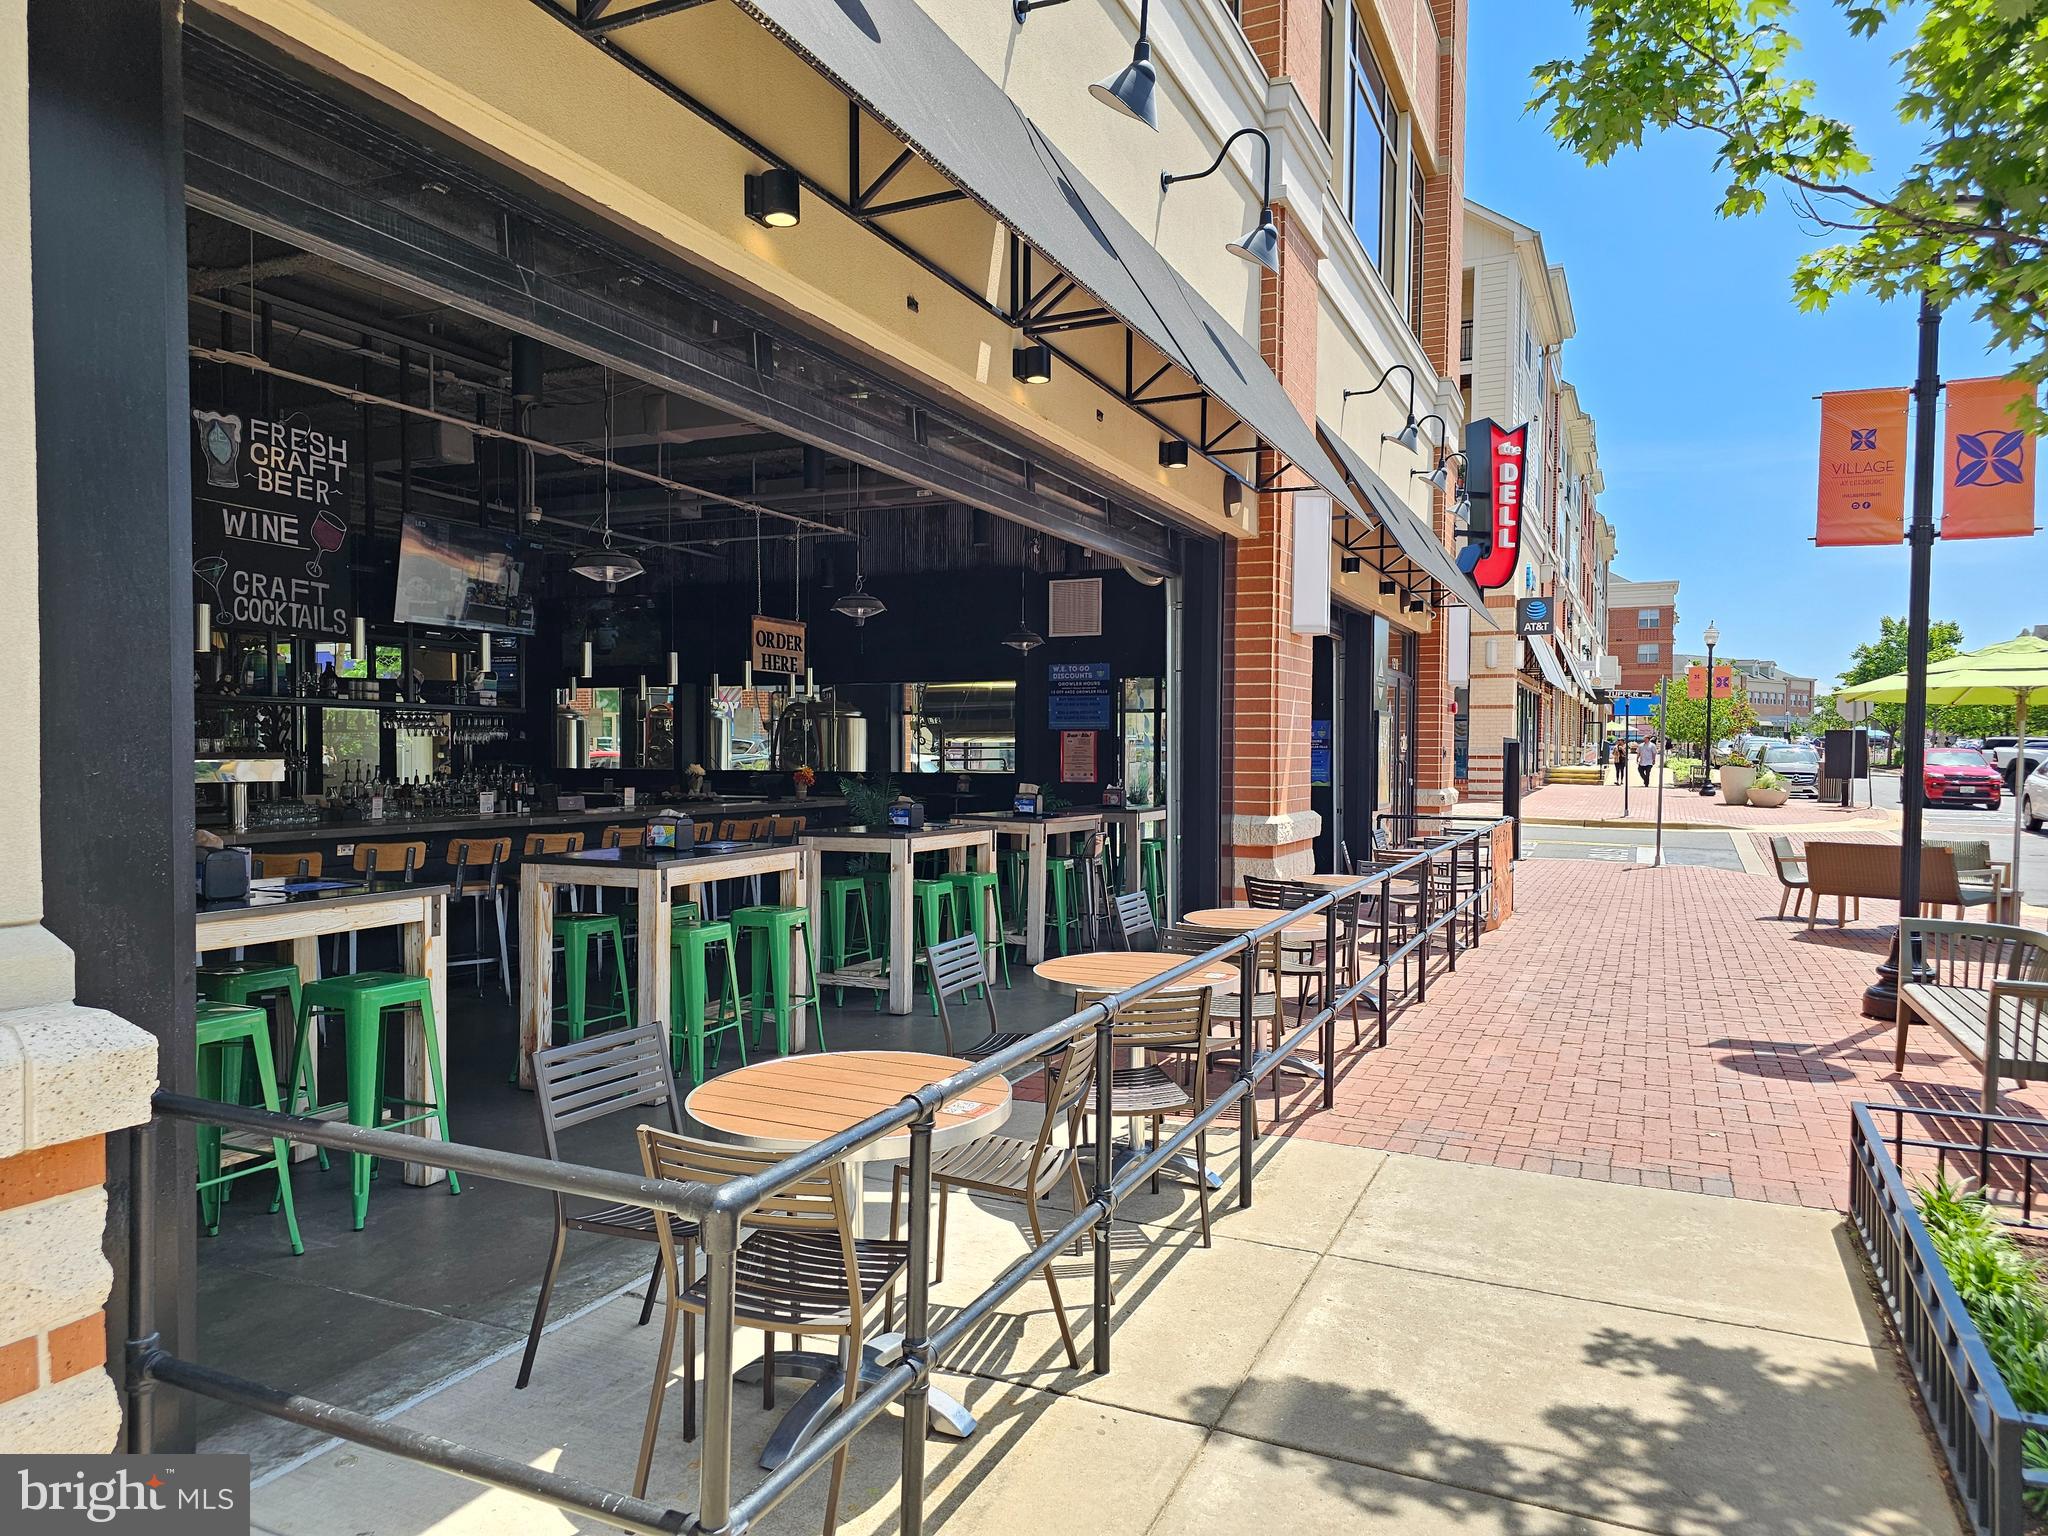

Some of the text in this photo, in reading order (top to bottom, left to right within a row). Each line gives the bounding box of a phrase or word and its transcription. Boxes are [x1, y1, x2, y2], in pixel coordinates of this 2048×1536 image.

[250, 418, 347, 463] FRESH
[250, 442, 348, 482] CRAFT
[1831, 460, 1895, 475] VILLAGE
[258, 467, 330, 506] BEER
[1498, 463, 1519, 548] DELL
[222, 508, 299, 545] WINE
[233, 570, 330, 605] CRAFT
[233, 596, 347, 635] COCKTAILS
[1523, 622, 1550, 632] AT&T
[756, 629, 803, 652] ORDER
[761, 653, 798, 673] HERE
[1052, 672, 1093, 680] DISCOUNTS
